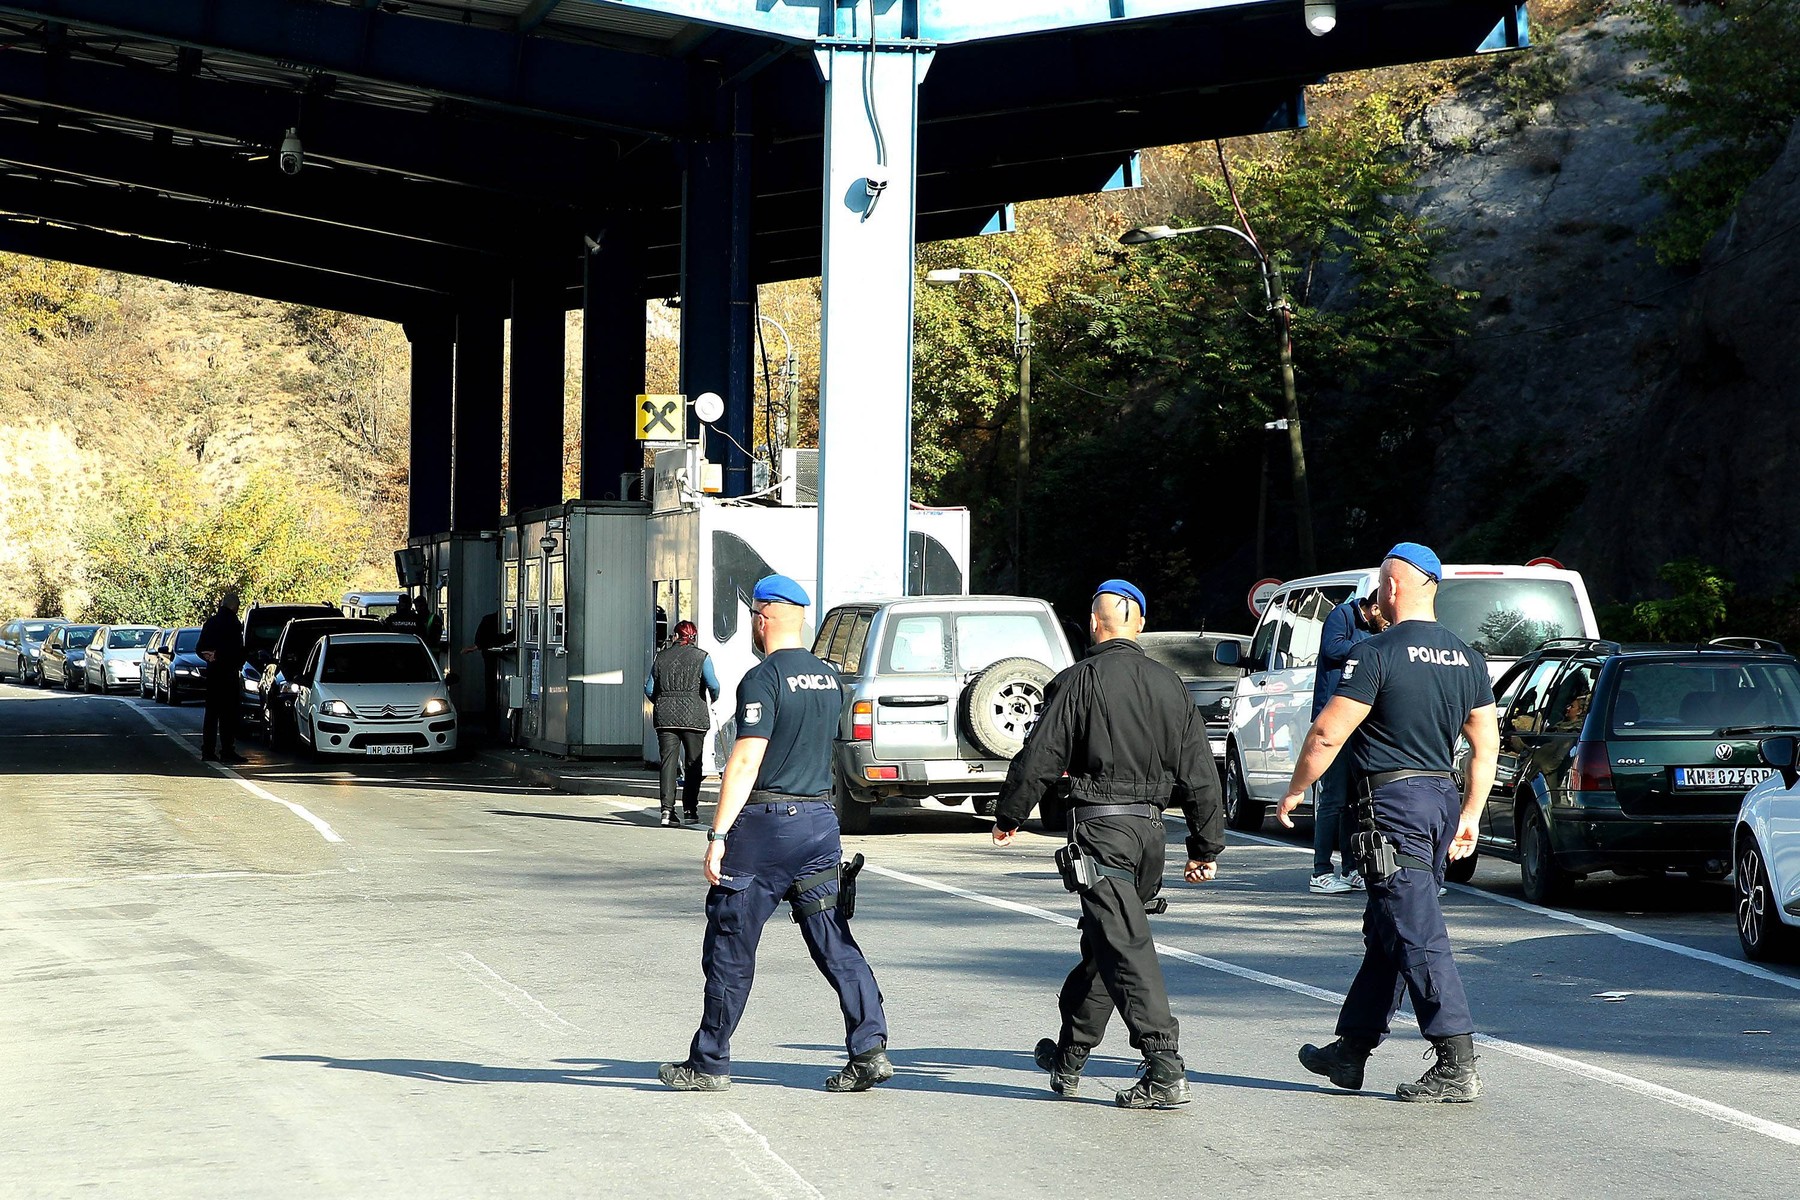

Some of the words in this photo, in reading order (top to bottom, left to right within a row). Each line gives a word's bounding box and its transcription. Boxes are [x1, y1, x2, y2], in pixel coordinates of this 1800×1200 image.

[1407, 645, 1470, 668] POLICJA
[786, 673, 839, 693] POLICJA
[1686, 769, 1706, 784] KM
